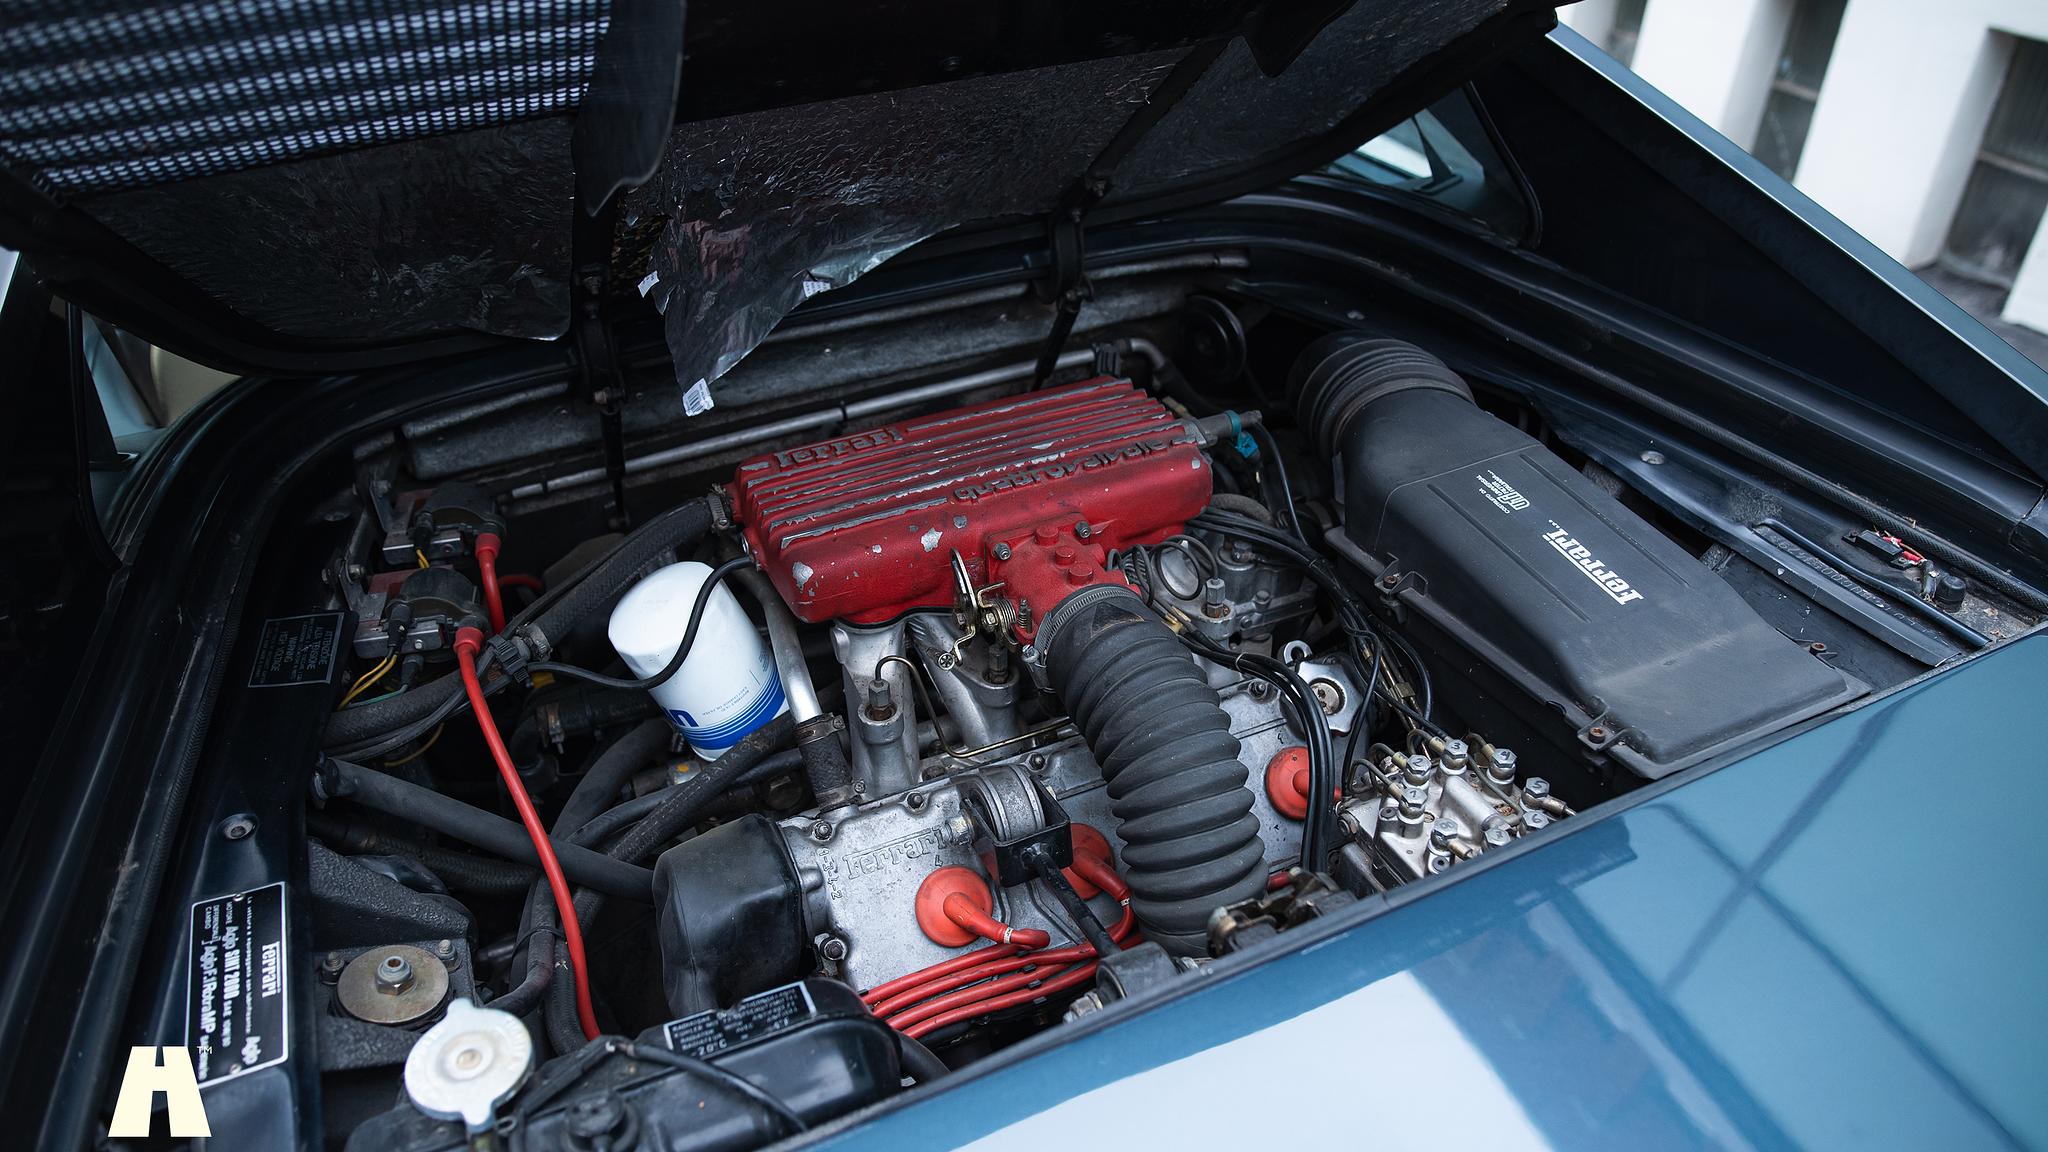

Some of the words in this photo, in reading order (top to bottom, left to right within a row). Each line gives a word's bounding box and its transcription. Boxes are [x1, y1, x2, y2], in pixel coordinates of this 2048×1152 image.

[774, 427, 903, 468] Ferrari
[1542, 527, 1644, 605] Ferrari
[842, 825, 947, 880] Ferrari
[222, 926, 240, 950] Agip
[200, 945, 219, 970] Agip
[261, 941, 281, 998] Ferrari
[223, 972, 241, 1000] 2000
[200, 1009, 217, 1034] MP
[241, 1035, 261, 1065] Agip
